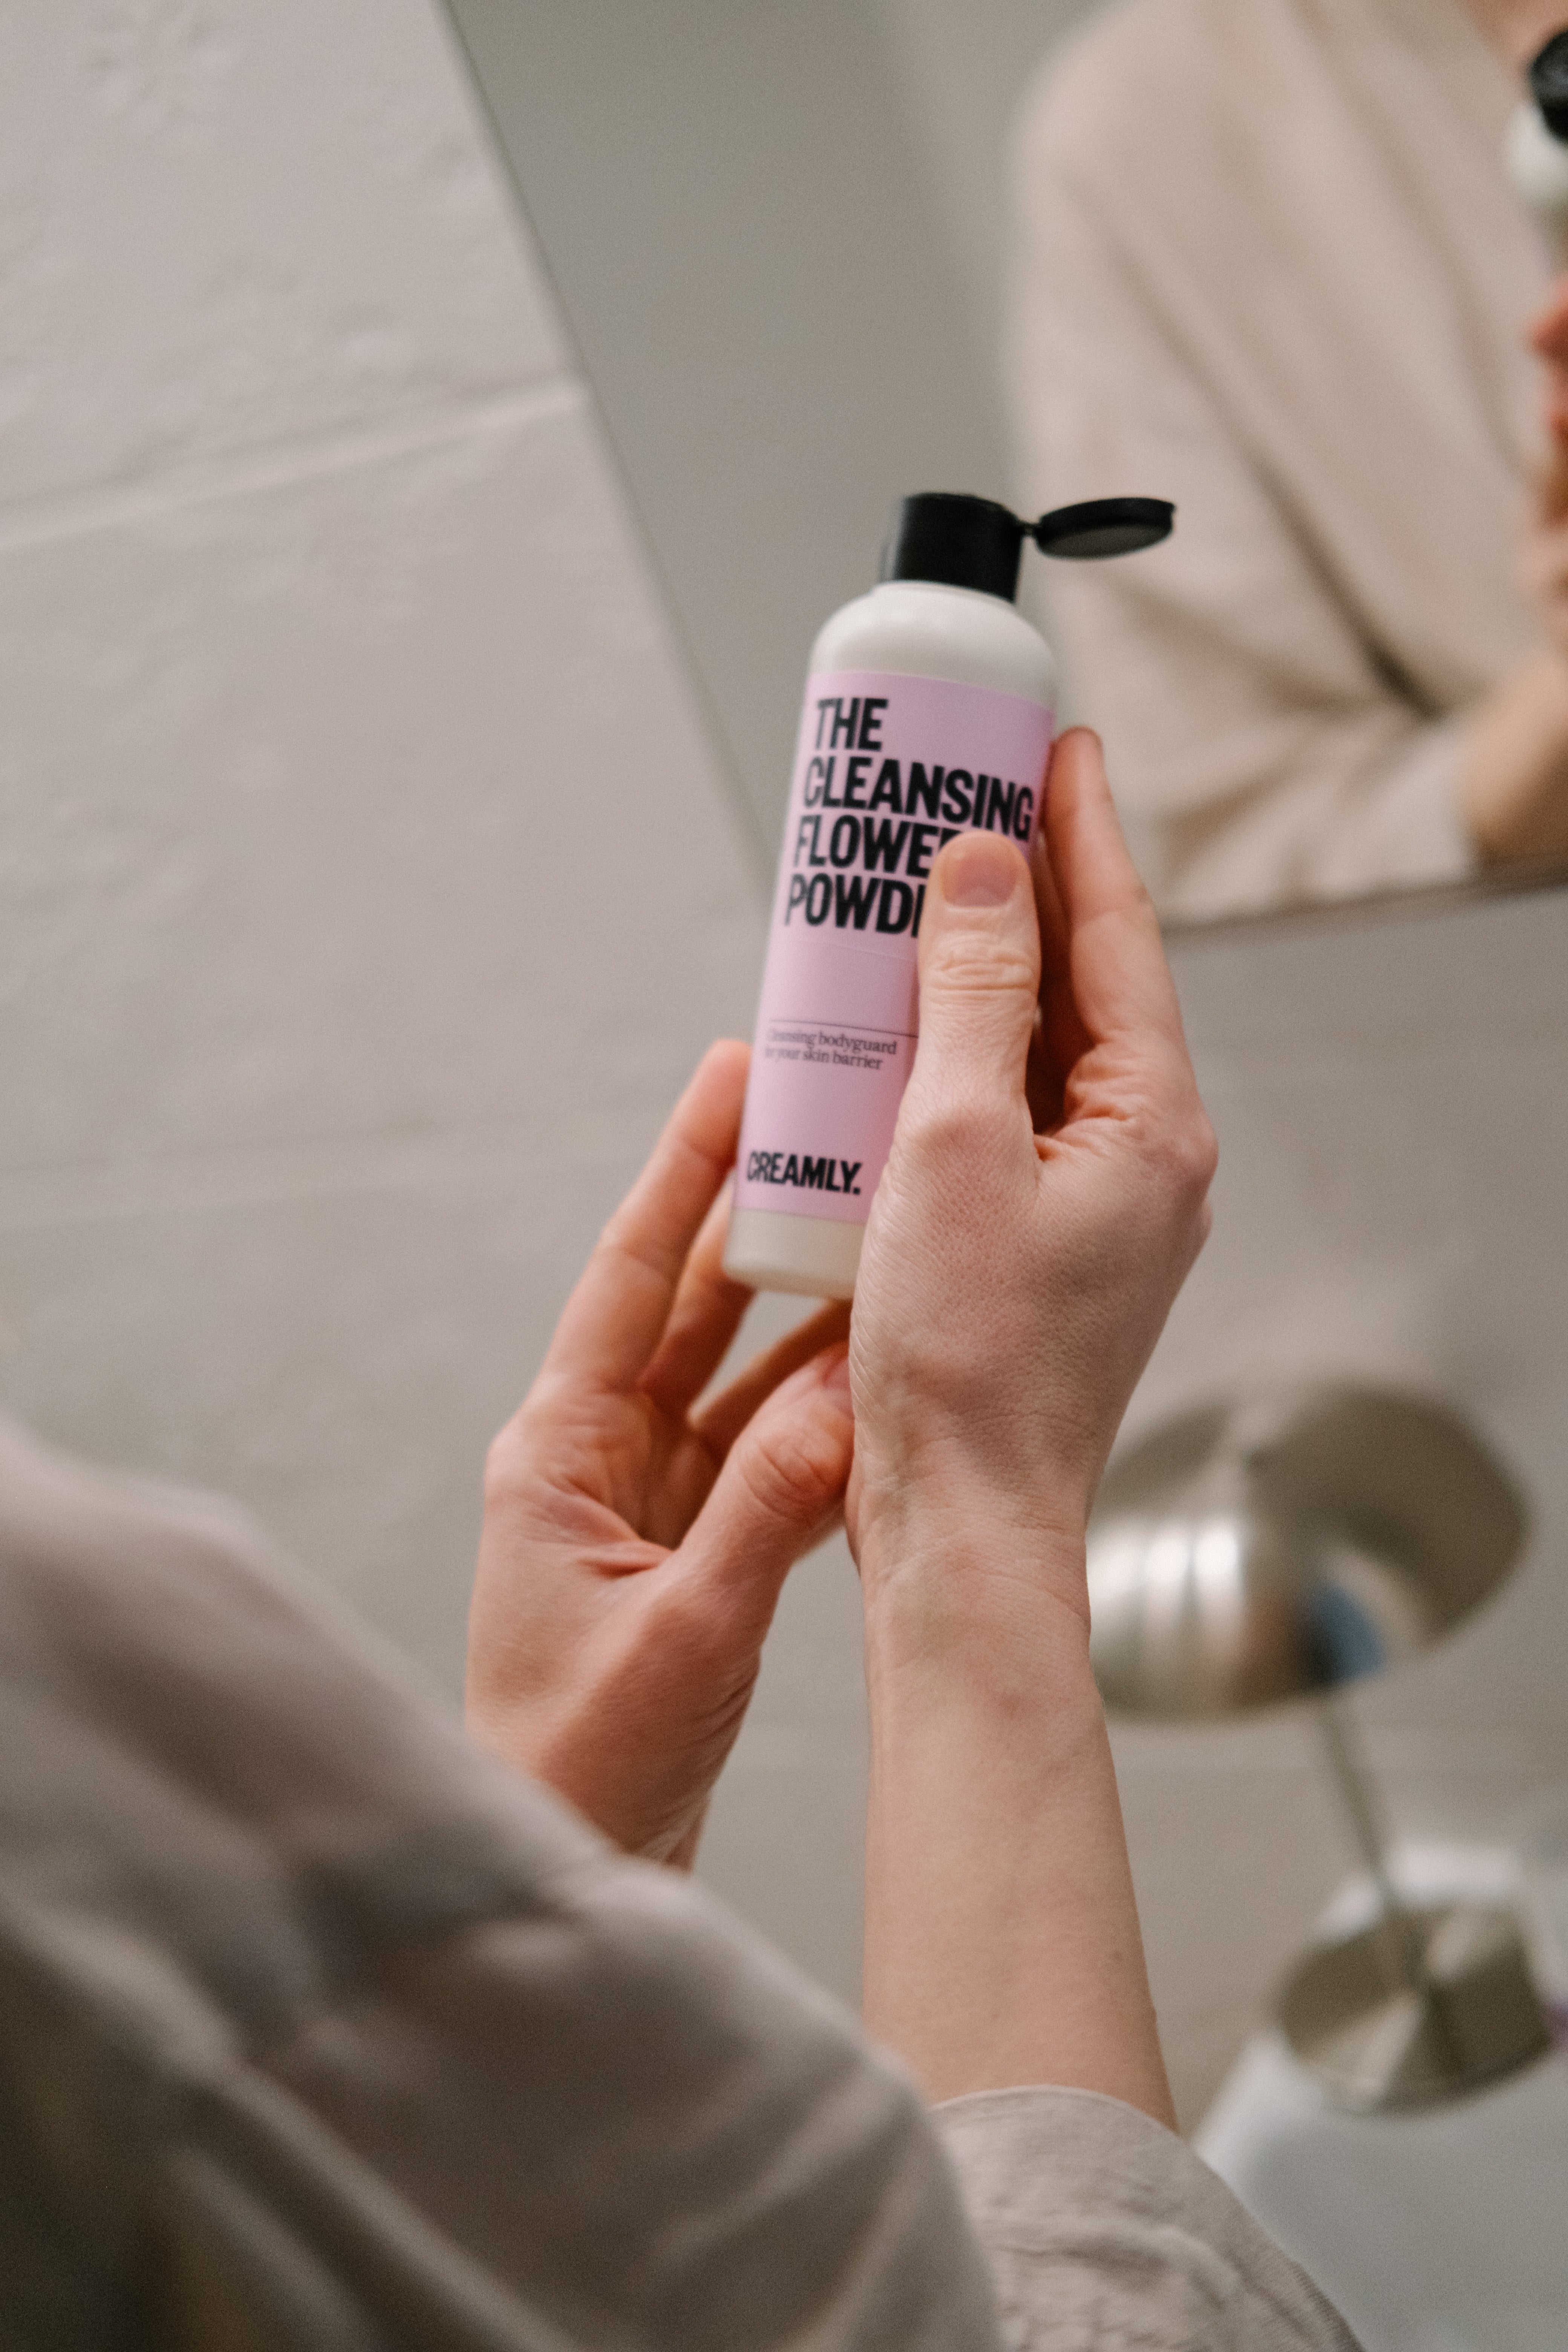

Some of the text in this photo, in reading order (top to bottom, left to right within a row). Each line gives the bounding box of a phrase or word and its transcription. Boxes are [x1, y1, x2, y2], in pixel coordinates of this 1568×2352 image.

[816, 697, 889, 751] THE
[804, 756, 1034, 841] CLEANSING
[793, 815, 963, 878] FLOWE
[802, 1048, 829, 1063] skin
[833, 1051, 882, 1070] barrier
[819, 1031, 897, 1055] bodyguard
[747, 1151, 862, 1195] CREAMLY.
